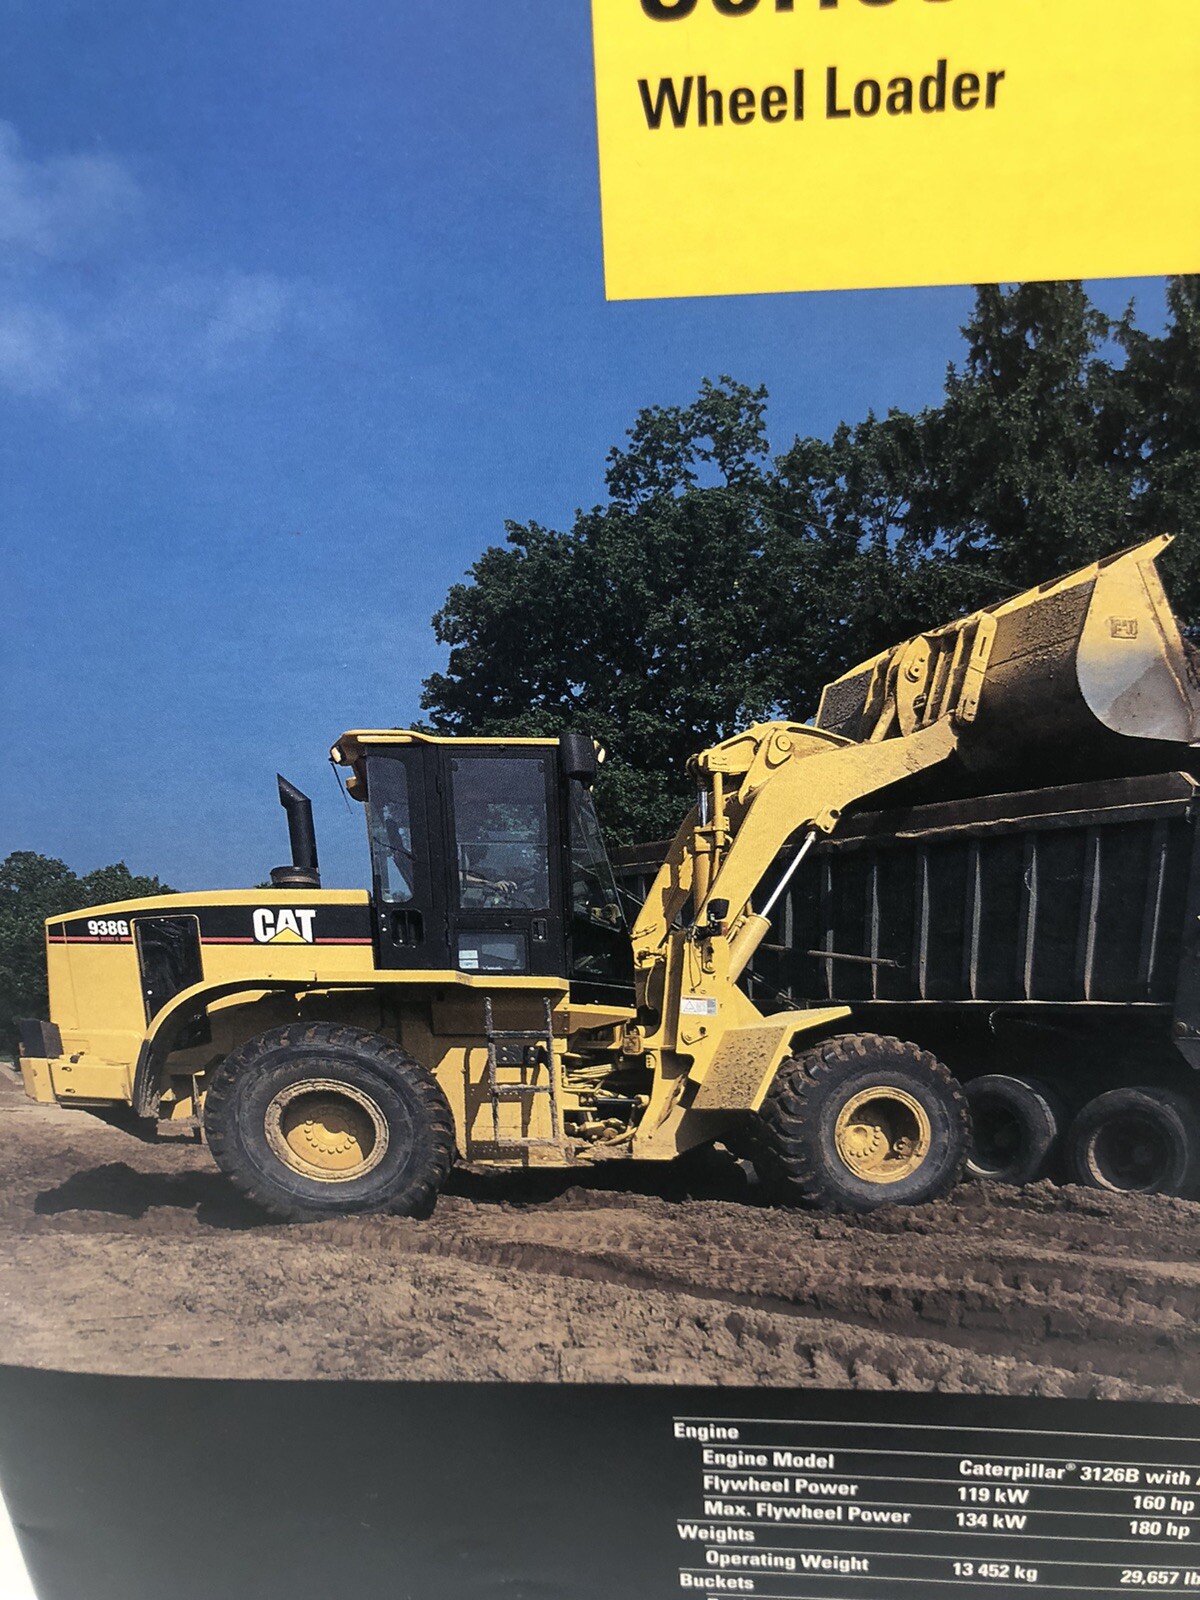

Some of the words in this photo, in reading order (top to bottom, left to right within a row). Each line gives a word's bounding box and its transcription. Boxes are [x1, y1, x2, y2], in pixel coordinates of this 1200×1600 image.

[637, 68, 804, 129] Wheel
[826, 59, 1005, 118] Loader
[87, 920, 129, 936] 938G
[252, 908, 316, 943] CAT
[673, 1422, 739, 1442] Engine
[702, 1449, 768, 1469] Engine
[773, 1451, 834, 1469] Model
[703, 1475, 790, 1494] Flywheel
[795, 1478, 858, 1496] Power
[1079, 1466, 1140, 1483] 3126B
[1145, 1469, 1191, 1486] with
[957, 1486, 991, 1502] 119
[994, 1487, 1030, 1504] kW
[1133, 1495, 1166, 1511] 160
[1170, 1496, 1195, 1515] hp
[704, 1500, 751, 1517] Max.
[756, 1502, 843, 1521] Flywheel
[848, 1506, 911, 1524] Power
[956, 1512, 988, 1528] 134
[992, 1513, 1027, 1530] kW
[677, 1524, 755, 1544] Weights
[1129, 1520, 1162, 1536] 180
[1166, 1521, 1191, 1540] hp
[706, 1550, 796, 1570] Operating
[801, 1554, 869, 1572] Weight
[680, 1573, 755, 1589] Buckets
[952, 1562, 974, 1577] 13
[977, 1563, 1010, 1578] 452
[1014, 1564, 1038, 1583] kg
[1120, 1569, 1180, 1585] 29,657
